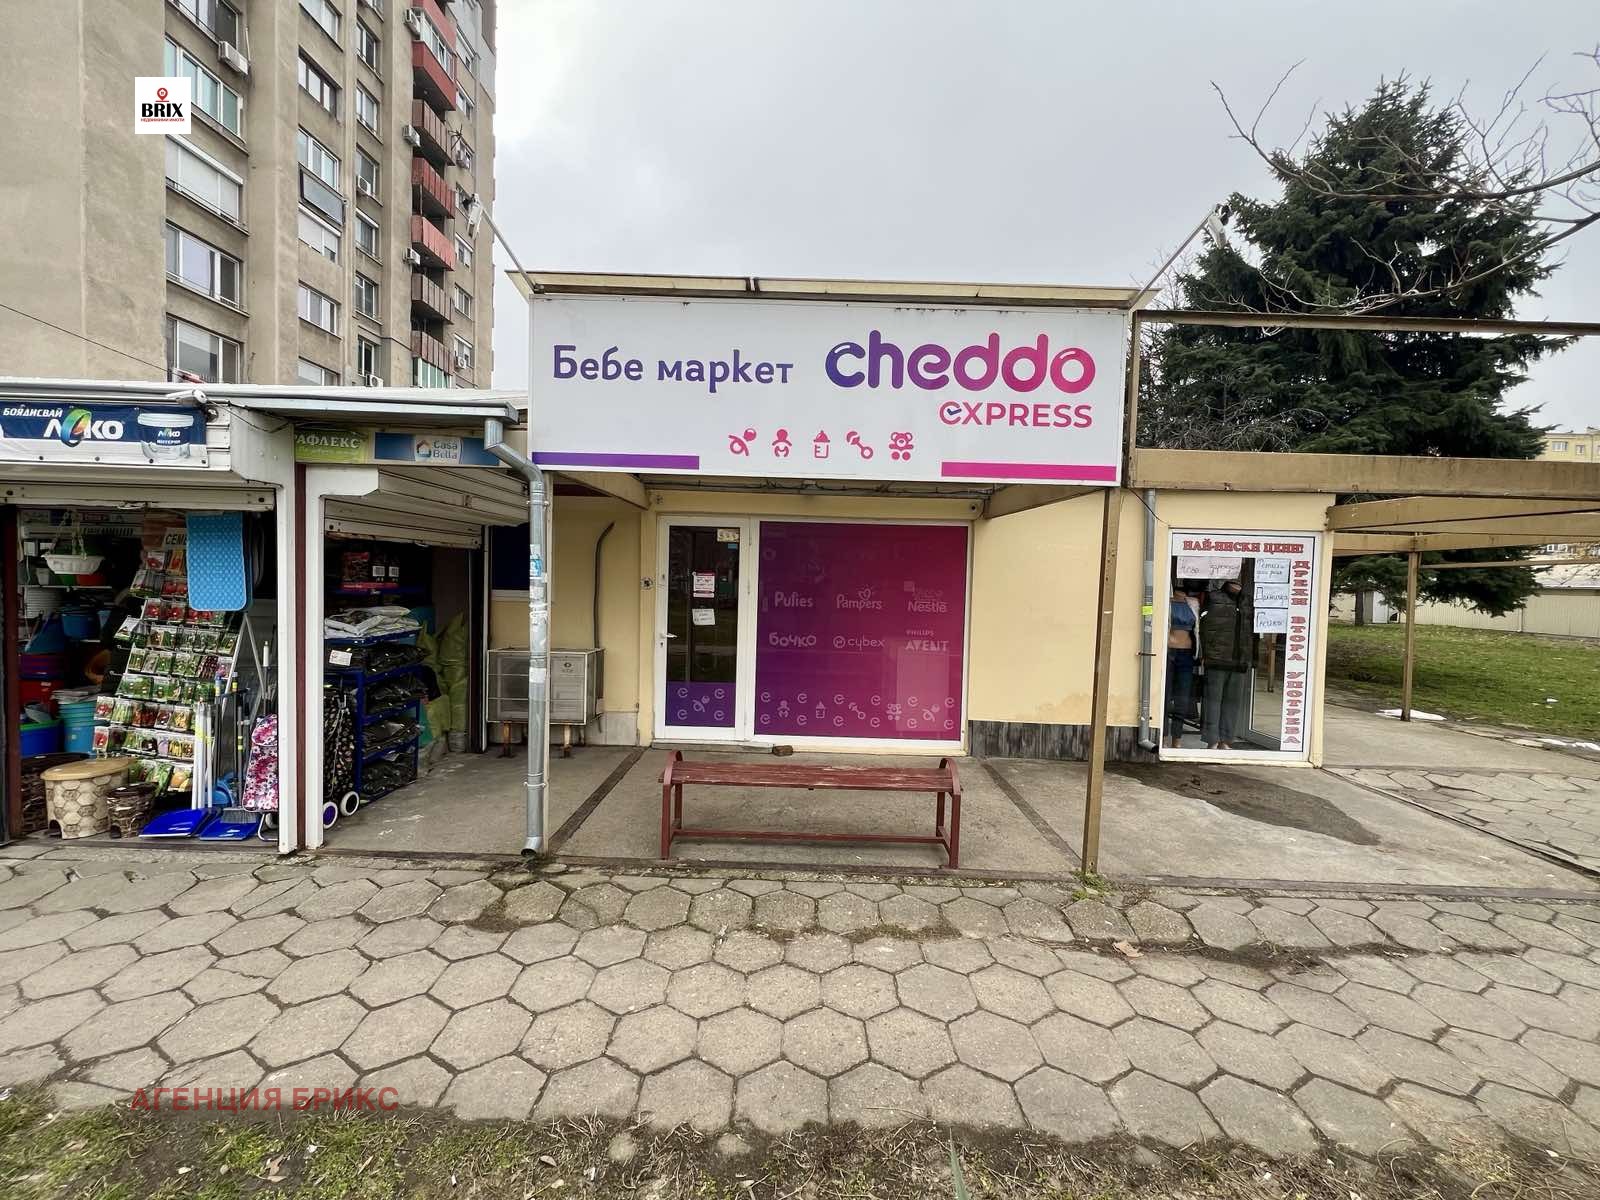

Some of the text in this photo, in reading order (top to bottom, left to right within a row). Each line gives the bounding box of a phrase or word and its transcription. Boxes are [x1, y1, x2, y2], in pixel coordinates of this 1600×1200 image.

[553, 345, 794, 393] Бебе маркет
[825, 329, 1096, 393] cheddo
[3, 407, 63, 417] БОЯДИСВАЙ
[433, 439, 458, 450] Casa
[1183, 539, 1260, 553] НАЙ-НИСКИ
[836, 594, 883, 611] Pampers
[847, 634, 886, 651] cybex
[1283, 560, 1311, 744] ДРЕХИ ВТОРА УПОТРЕБА
